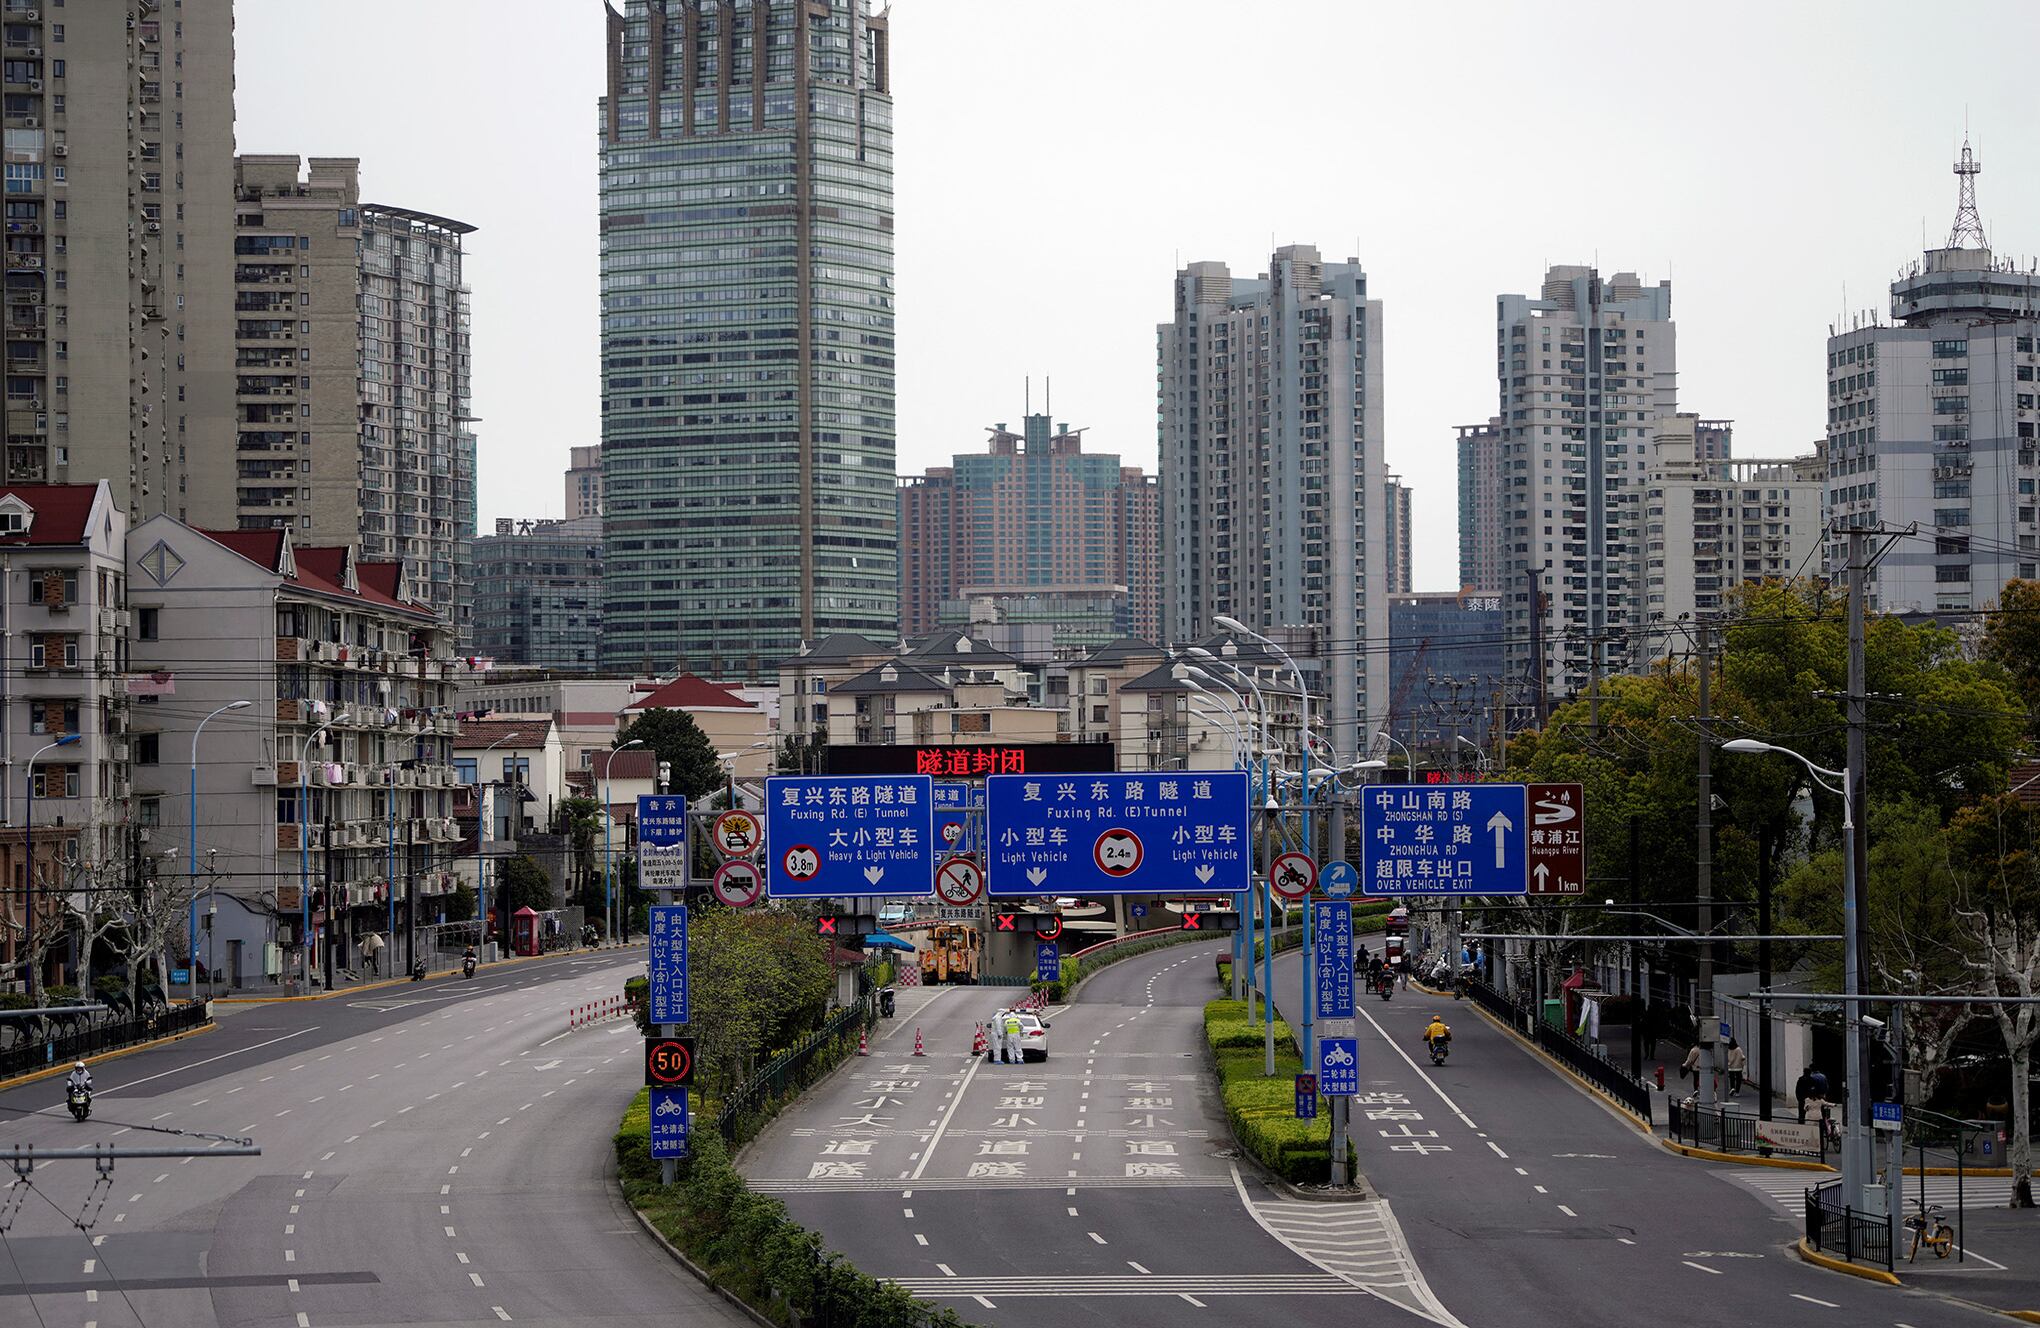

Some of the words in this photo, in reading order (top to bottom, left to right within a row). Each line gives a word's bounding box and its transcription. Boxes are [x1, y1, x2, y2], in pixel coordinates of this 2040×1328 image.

[1467, 598, 1501, 611] 泰隆
[916, 748, 1025, 775] 隧道封闭
[781, 785, 918, 806] 复兴东路隧道
[1023, 780, 1213, 802] 复兴东路隧道
[1375, 790, 1473, 811] 中山南路
[790, 809, 825, 822] Fuxing
[831, 808, 848, 819] Rd.
[854, 807, 868, 819] (E)
[874, 807, 909, 819] Tunnel
[1047, 807, 1091, 821] Fuxing
[1098, 806, 1117, 818] Rd.
[1124, 807, 1141, 818] (E)
[1143, 805, 1188, 818] Tunnel
[1384, 811, 1433, 822] ZHONGSHAN
[1437, 811, 1448, 821] RD
[1452, 810, 1464, 822] (S)
[828, 827, 919, 848] 大小型车
[1000, 826, 1069, 847] 小型车
[1171, 824, 1238, 845] 小型车
[1375, 824, 1473, 845] 中华路
[1530, 829, 1580, 845] 黄浦江
[828, 850, 853, 864] Heavy
[856, 850, 863, 861] &
[866, 849, 886, 863] Light
[889, 849, 919, 861] Vehicle
[1001, 852, 1026, 865] Light
[1031, 850, 1068, 863] Vehicle
[1106, 847, 1131, 859] 2.4m
[1172, 849, 1197, 863] Light
[1201, 848, 1239, 860] Vehicle
[1389, 844, 1439, 857] ZHONGHUA
[1445, 844, 1458, 856] RD
[1531, 846, 1560, 857] Huangpu
[1562, 846, 1580, 855] River
[790, 853, 814, 873] 3.8m
[1375, 859, 1473, 878] 超限车出口
[1376, 878, 1402, 890] OVER
[1405, 878, 1446, 890] VEHICLE
[1452, 877, 1473, 889] EXIT
[1557, 876, 1580, 892] 1km
[940, 908, 981, 919] 复兴东路隧道
[671, 914, 683, 1015] 由大型车入口过江
[1336, 909, 1350, 1010] 由大型车入口过江
[658, 1052, 681, 1070] 50
